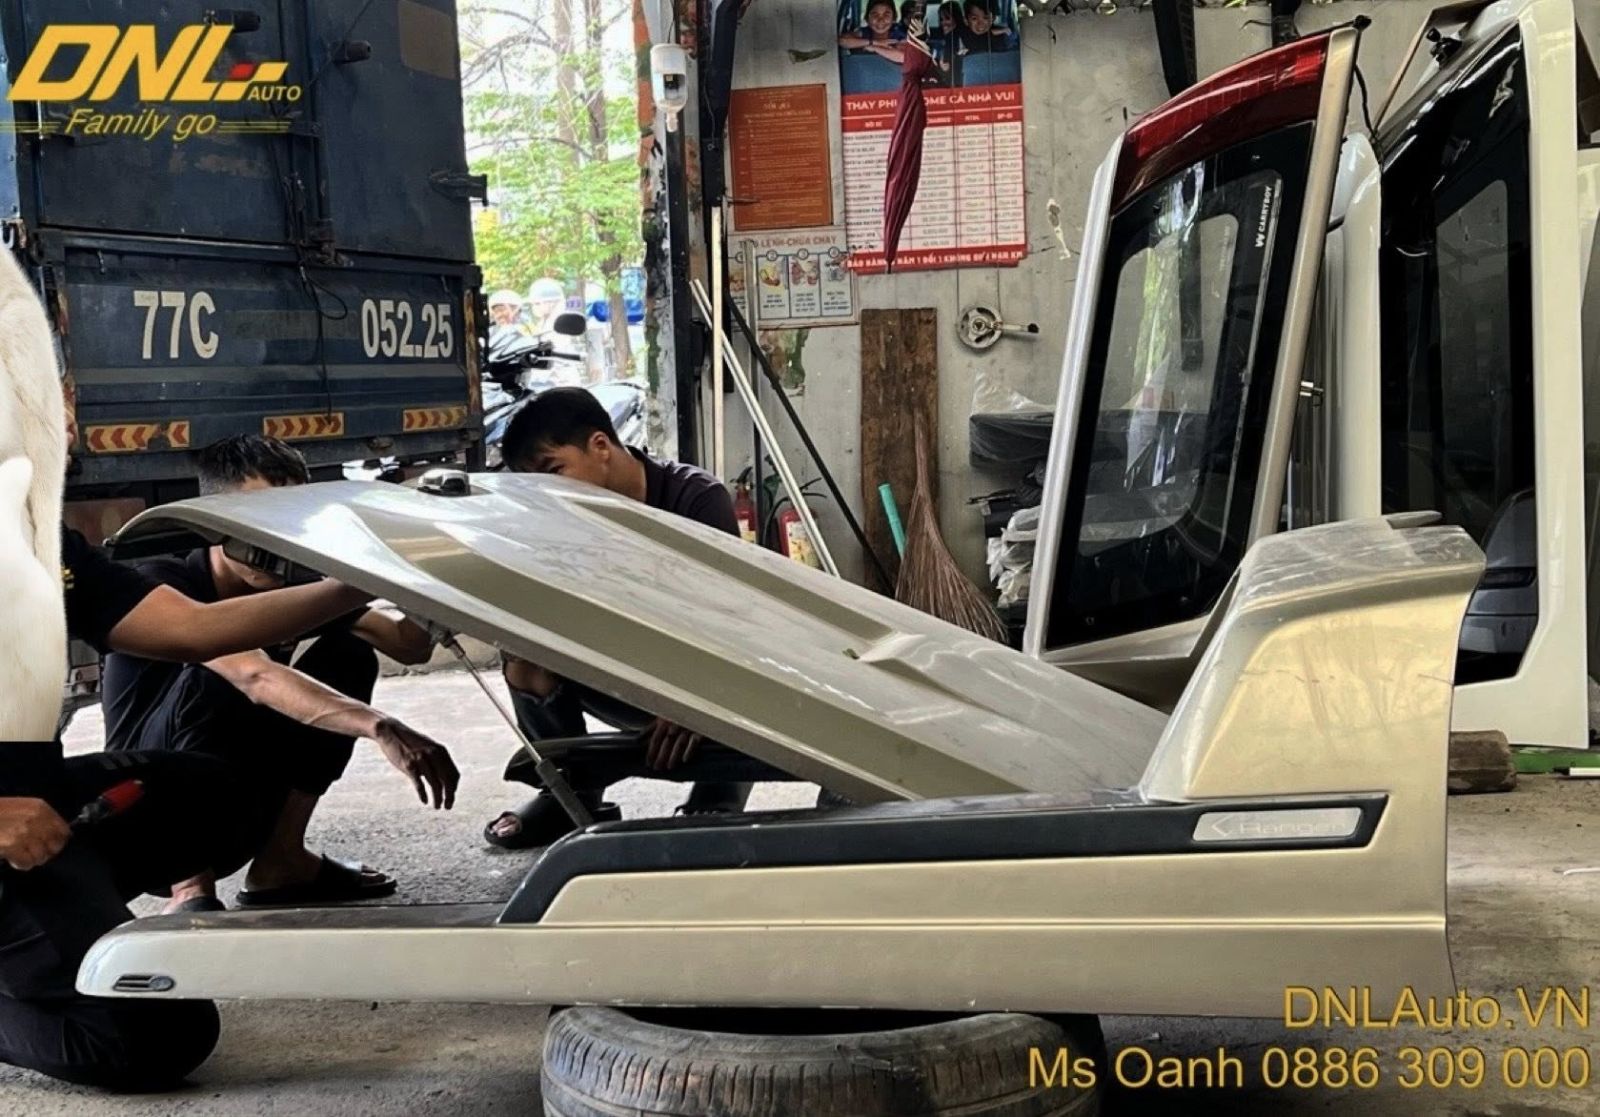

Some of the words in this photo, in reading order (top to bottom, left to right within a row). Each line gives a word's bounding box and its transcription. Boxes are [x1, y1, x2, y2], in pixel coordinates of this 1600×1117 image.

[846, 100, 876, 111] THAY
[995, 91, 1015, 102] VUI
[133, 290, 219, 360] 77C
[361, 298, 454, 359] 052.25
